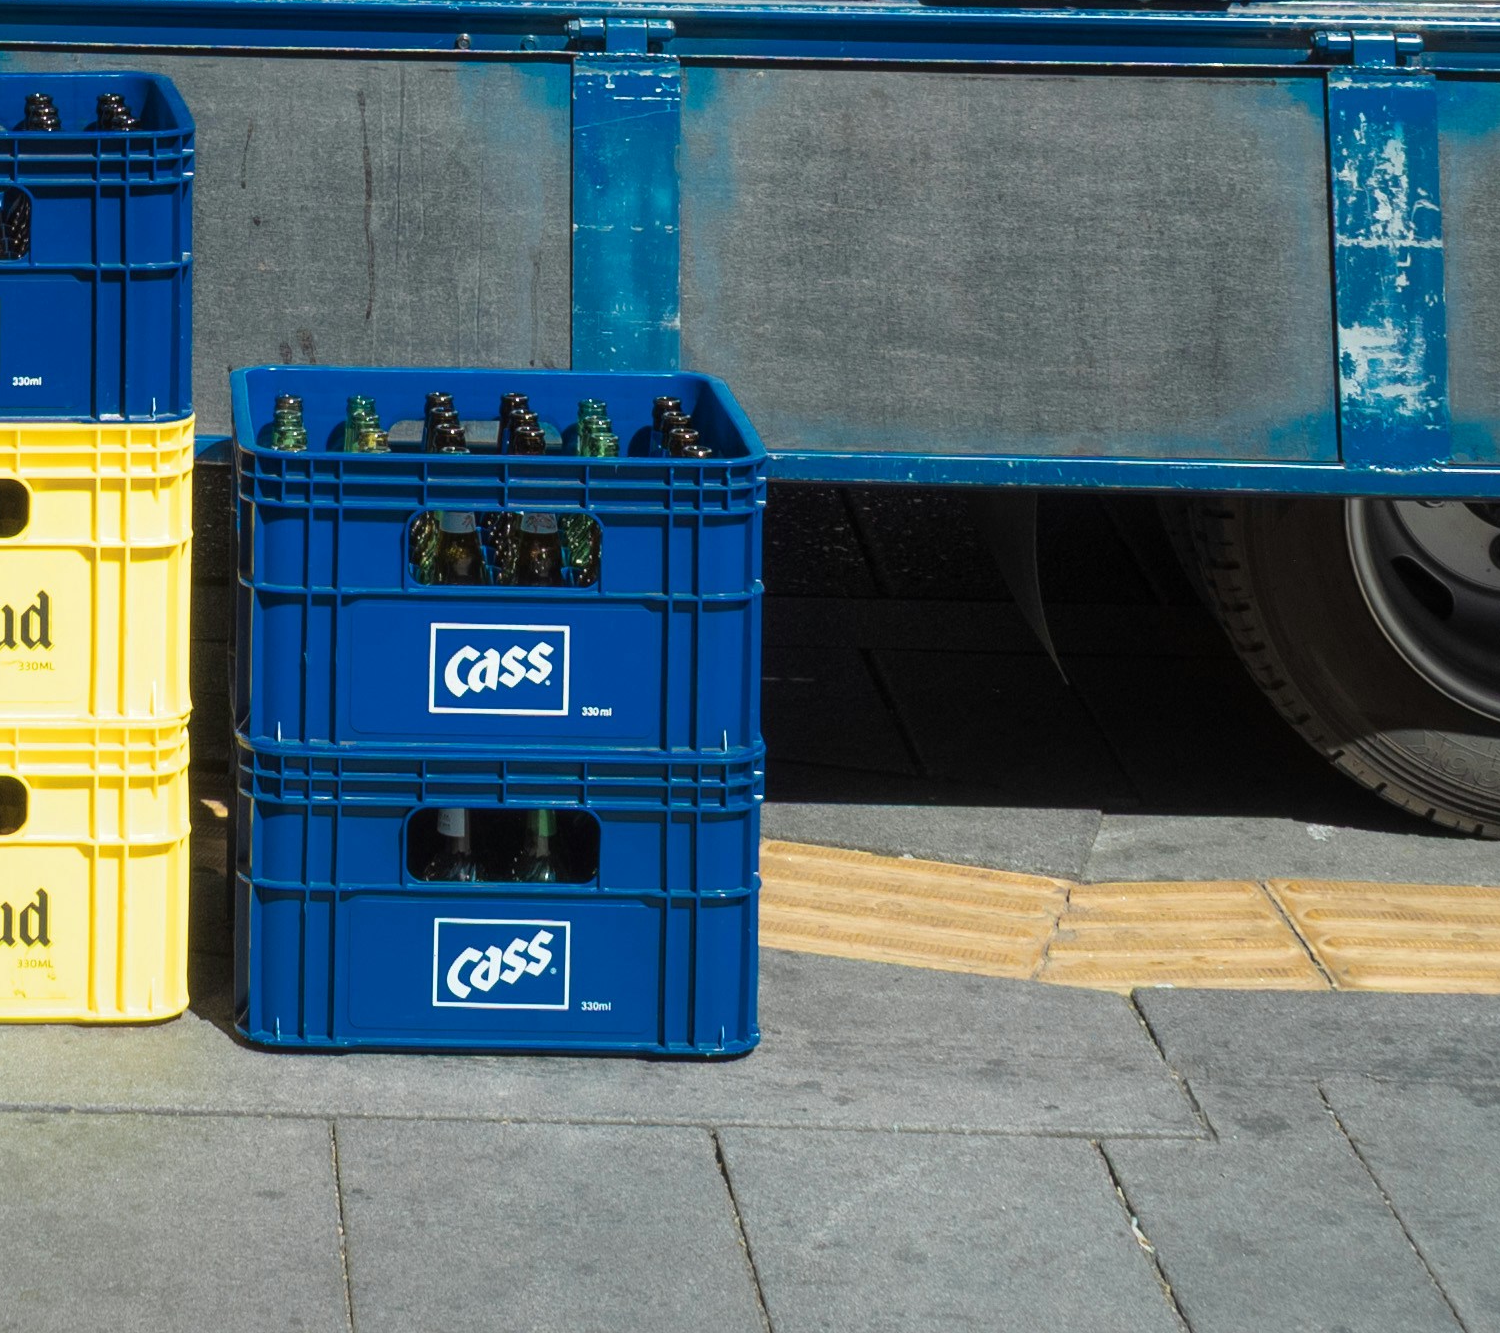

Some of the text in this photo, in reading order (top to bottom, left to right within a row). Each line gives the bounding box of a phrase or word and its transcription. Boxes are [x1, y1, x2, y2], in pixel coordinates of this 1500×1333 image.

[11, 375, 43, 387] 330ml
[17, 660, 56, 672] 330ML
[443, 639, 550, 700] Cass
[581, 707, 613, 717] 330ml
[16, 957, 54, 969] 330ML
[446, 932, 555, 997] Cass
[581, 1001, 612, 1012] 330ml
